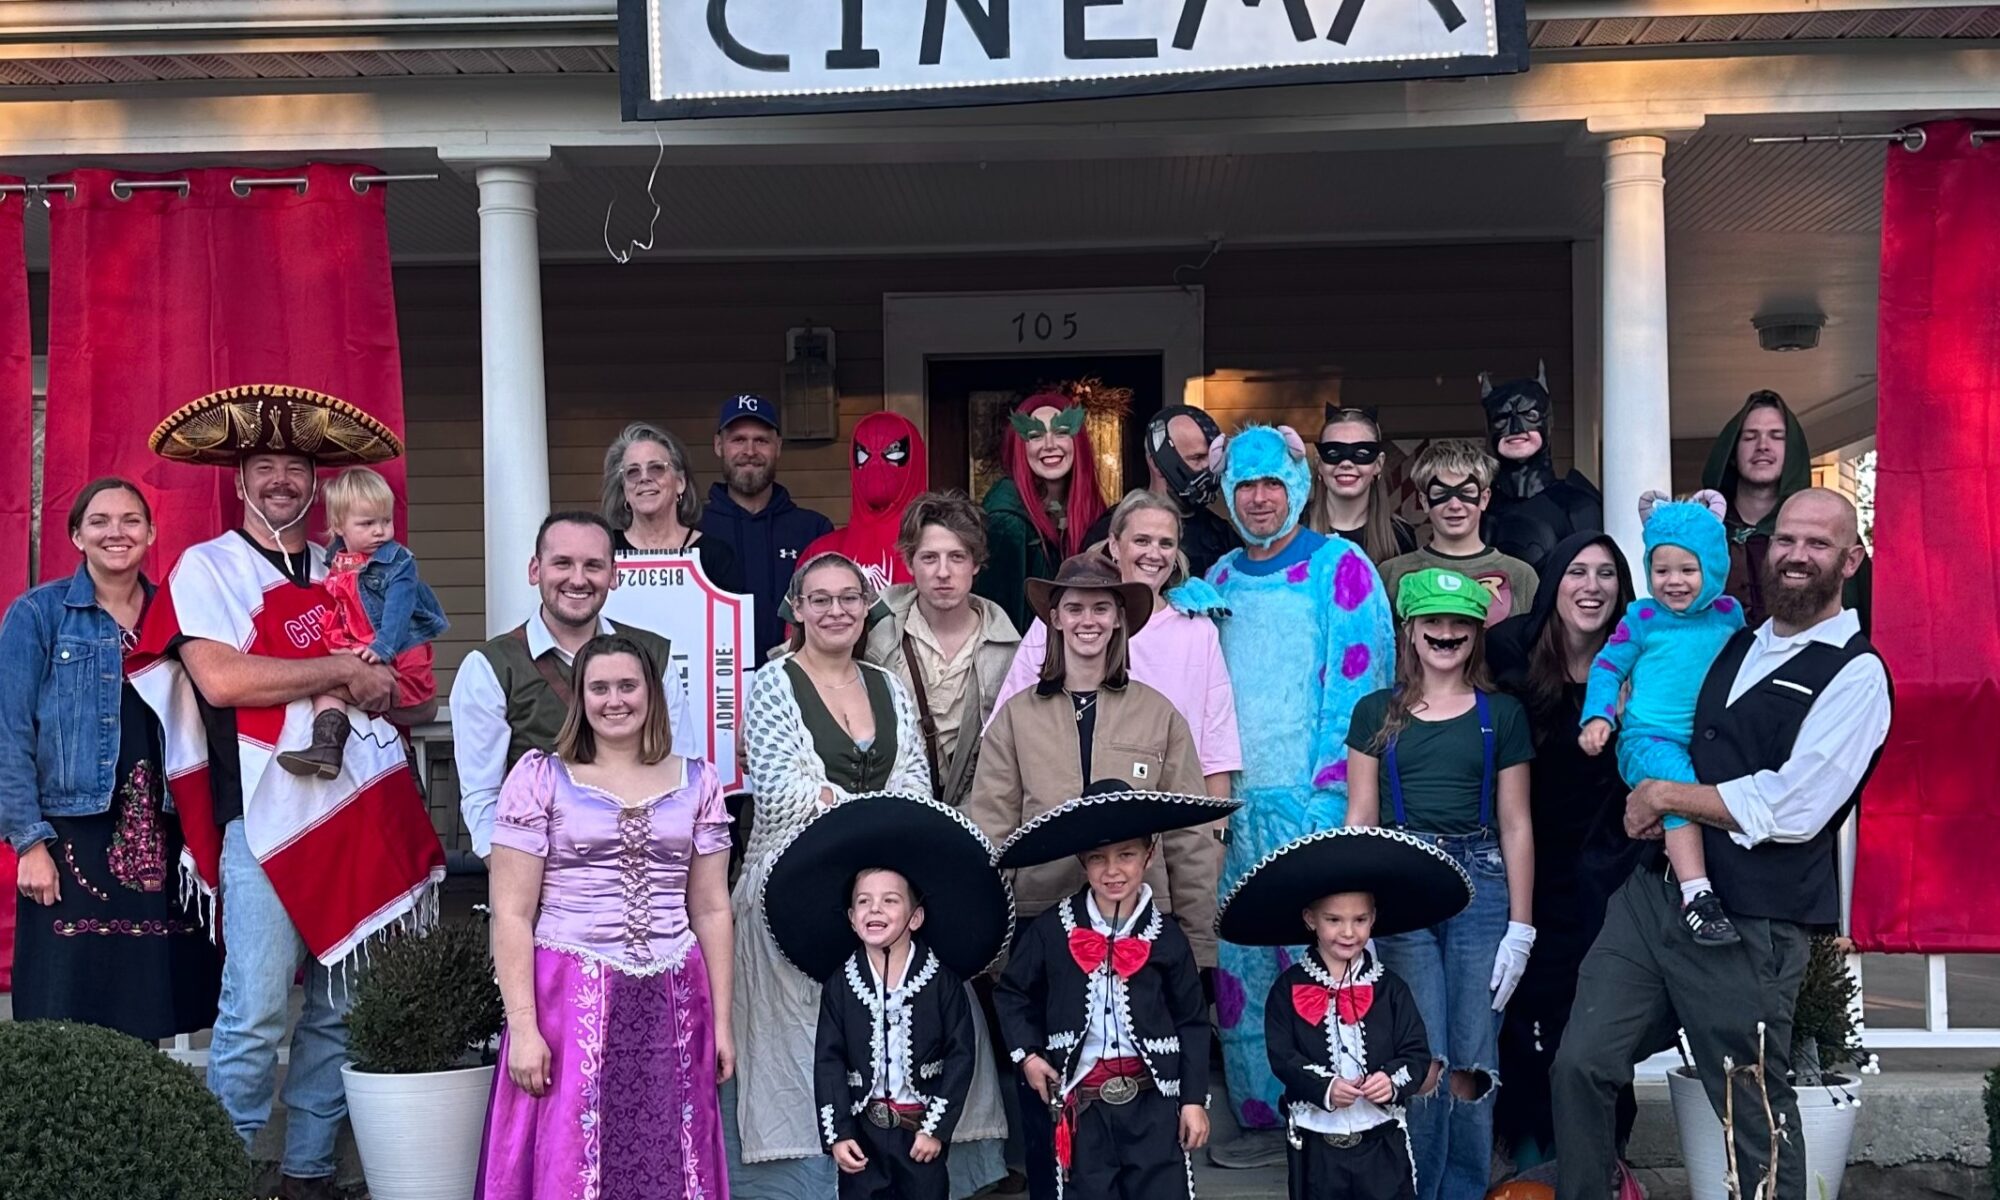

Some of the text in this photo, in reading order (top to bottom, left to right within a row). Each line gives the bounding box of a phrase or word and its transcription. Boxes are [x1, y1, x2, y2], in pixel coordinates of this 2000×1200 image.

[1011, 311, 1078, 344] 105
[738, 394, 758, 412] KC
[617, 568, 684, 587] B153024
[716, 648, 734, 731] ADMIT ONE
